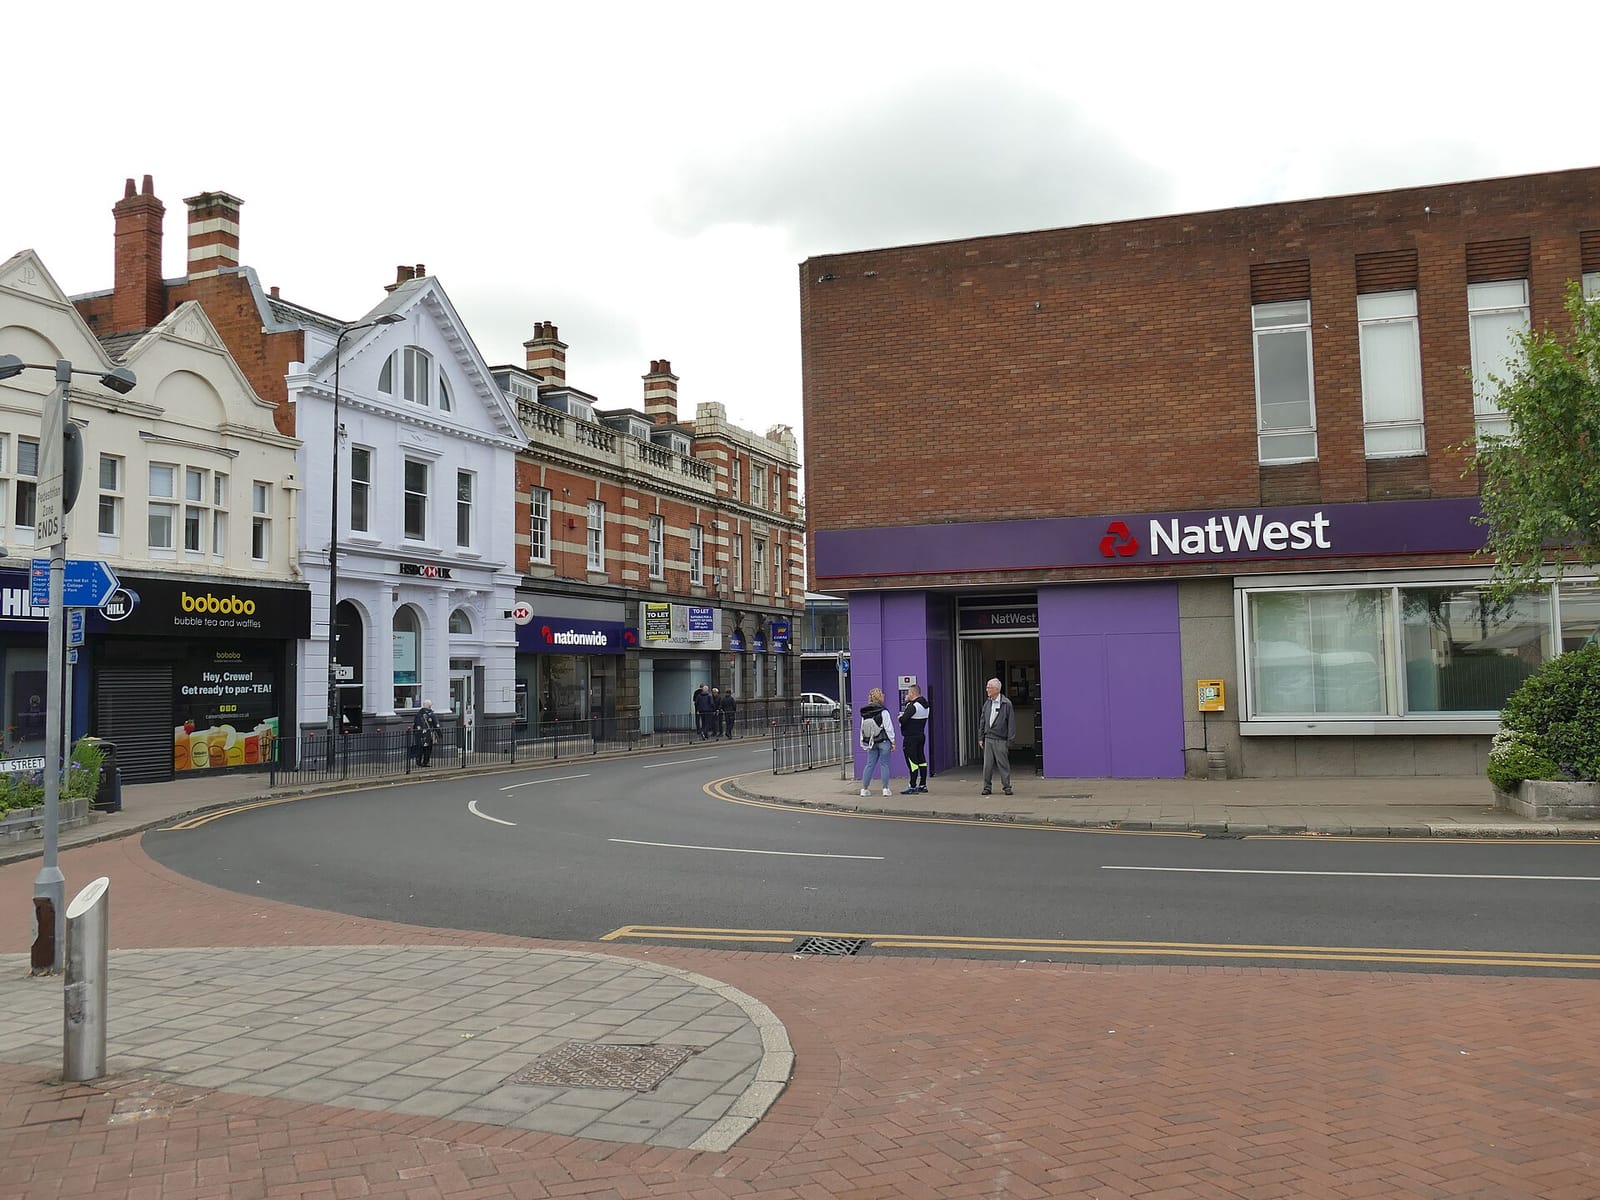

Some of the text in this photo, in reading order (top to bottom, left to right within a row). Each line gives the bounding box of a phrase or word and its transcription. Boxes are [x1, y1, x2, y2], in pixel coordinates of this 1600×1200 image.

[42, 505, 54, 516] Zone
[38, 517, 58, 540] ENDS
[1150, 511, 1331, 556] NatWest
[400, 562, 452, 578] HSBC UK
[2, 588, 50, 617] HI
[182, 592, 256, 615] bobobo
[106, 603, 125, 615] HILL
[174, 616, 202, 626] bubble
[236, 620, 261, 628] waffles
[992, 613, 1036, 624] NatWest
[554, 629, 607, 646] nationwide
[203, 672, 253, 683] Hey, Crewe!
[182, 684, 272, 696] Get ready to par-TEA!
[11, 759, 42, 770] STREET
